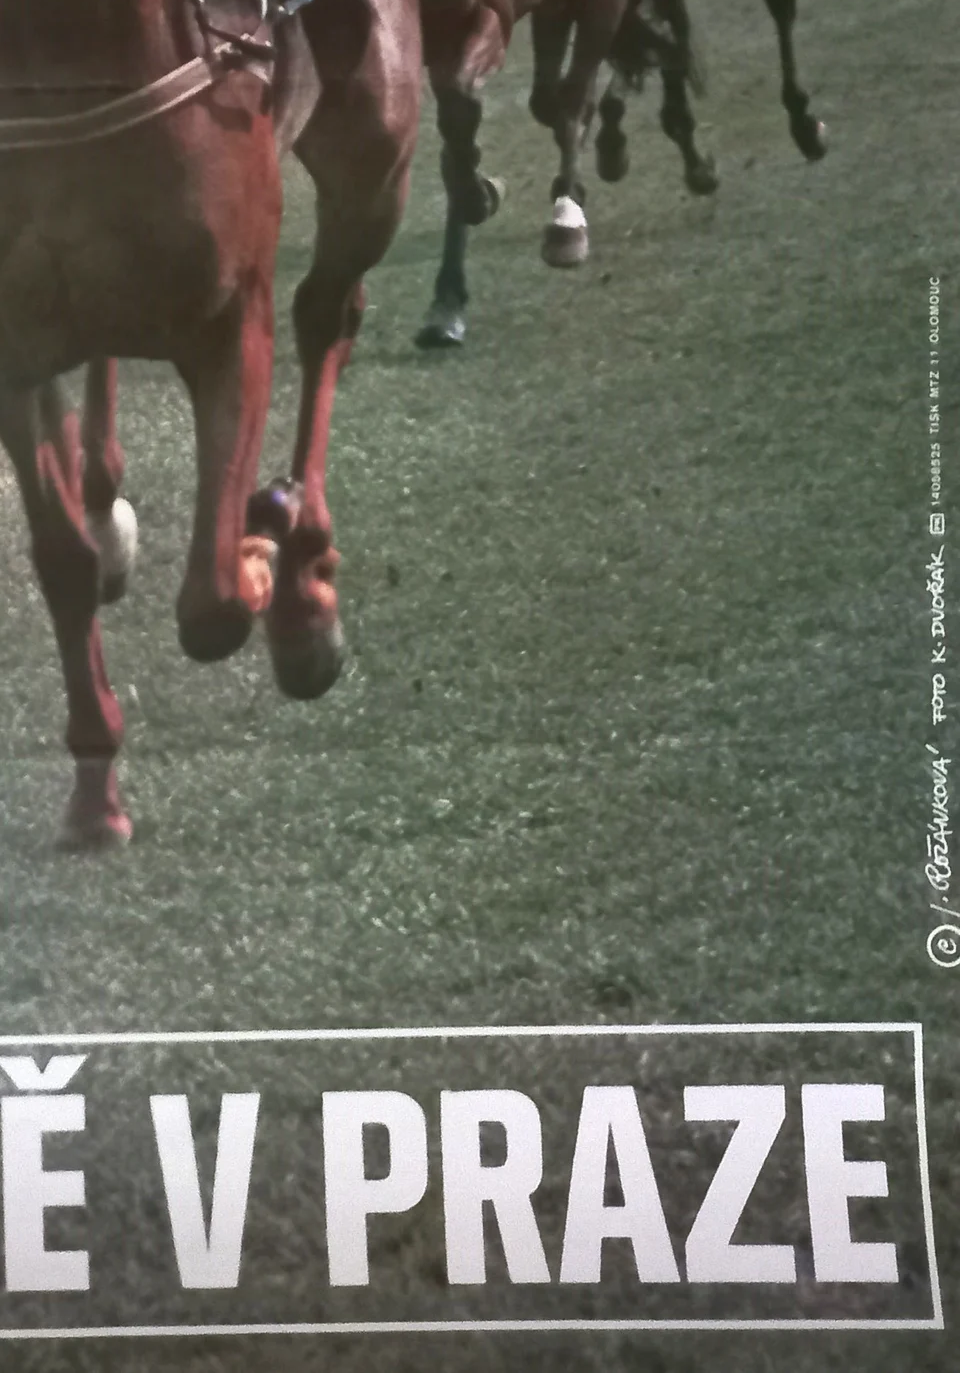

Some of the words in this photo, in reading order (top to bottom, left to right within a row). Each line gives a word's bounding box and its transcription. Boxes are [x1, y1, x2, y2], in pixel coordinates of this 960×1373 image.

[929, 276, 940, 344] OLOMOUC
[929, 370, 939, 398] MTZ
[926, 544, 944, 637] DVOŘÁK
[932, 673, 946, 725] FOTO
[149, 1091, 261, 1289] V
[321, 1083, 899, 1287] PRAZE
